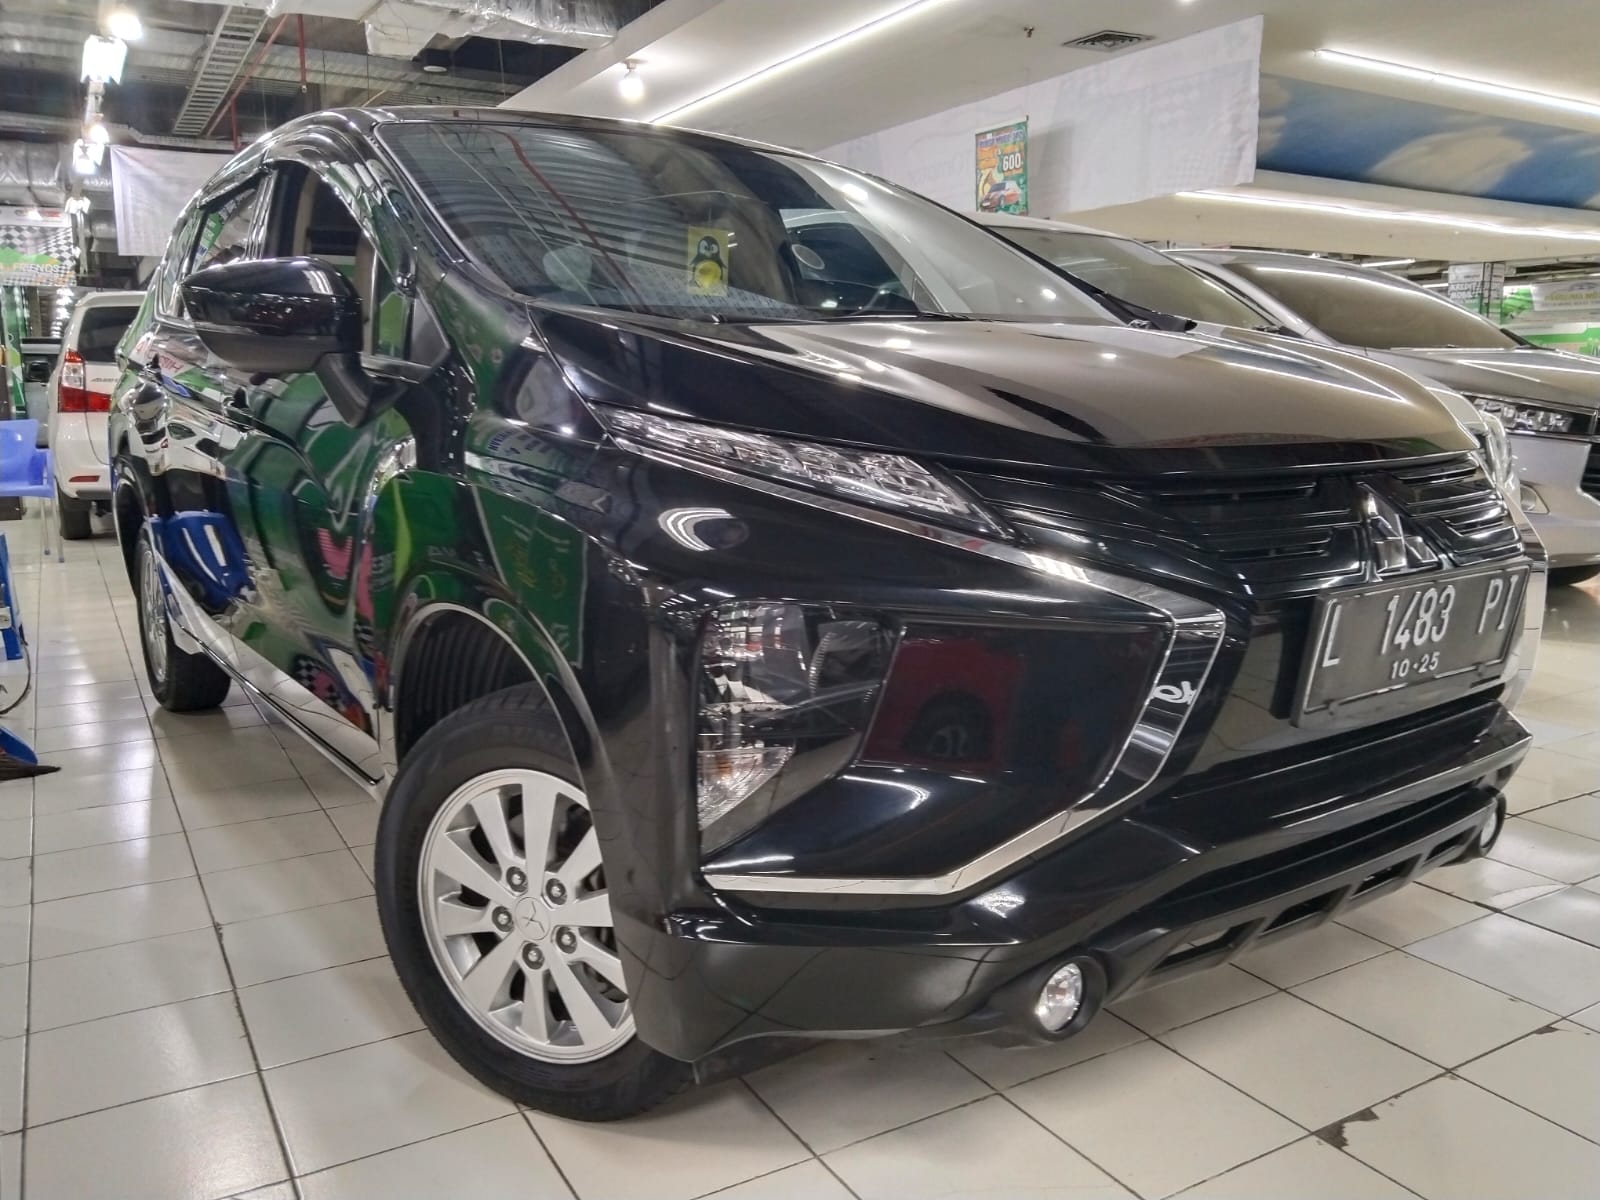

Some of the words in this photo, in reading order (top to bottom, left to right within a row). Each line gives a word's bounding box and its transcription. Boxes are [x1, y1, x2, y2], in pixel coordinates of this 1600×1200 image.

[1002, 153, 1021, 171] 600
[1322, 604, 1342, 668] L
[1381, 585, 1456, 655] 1483
[1478, 575, 1519, 634] PI
